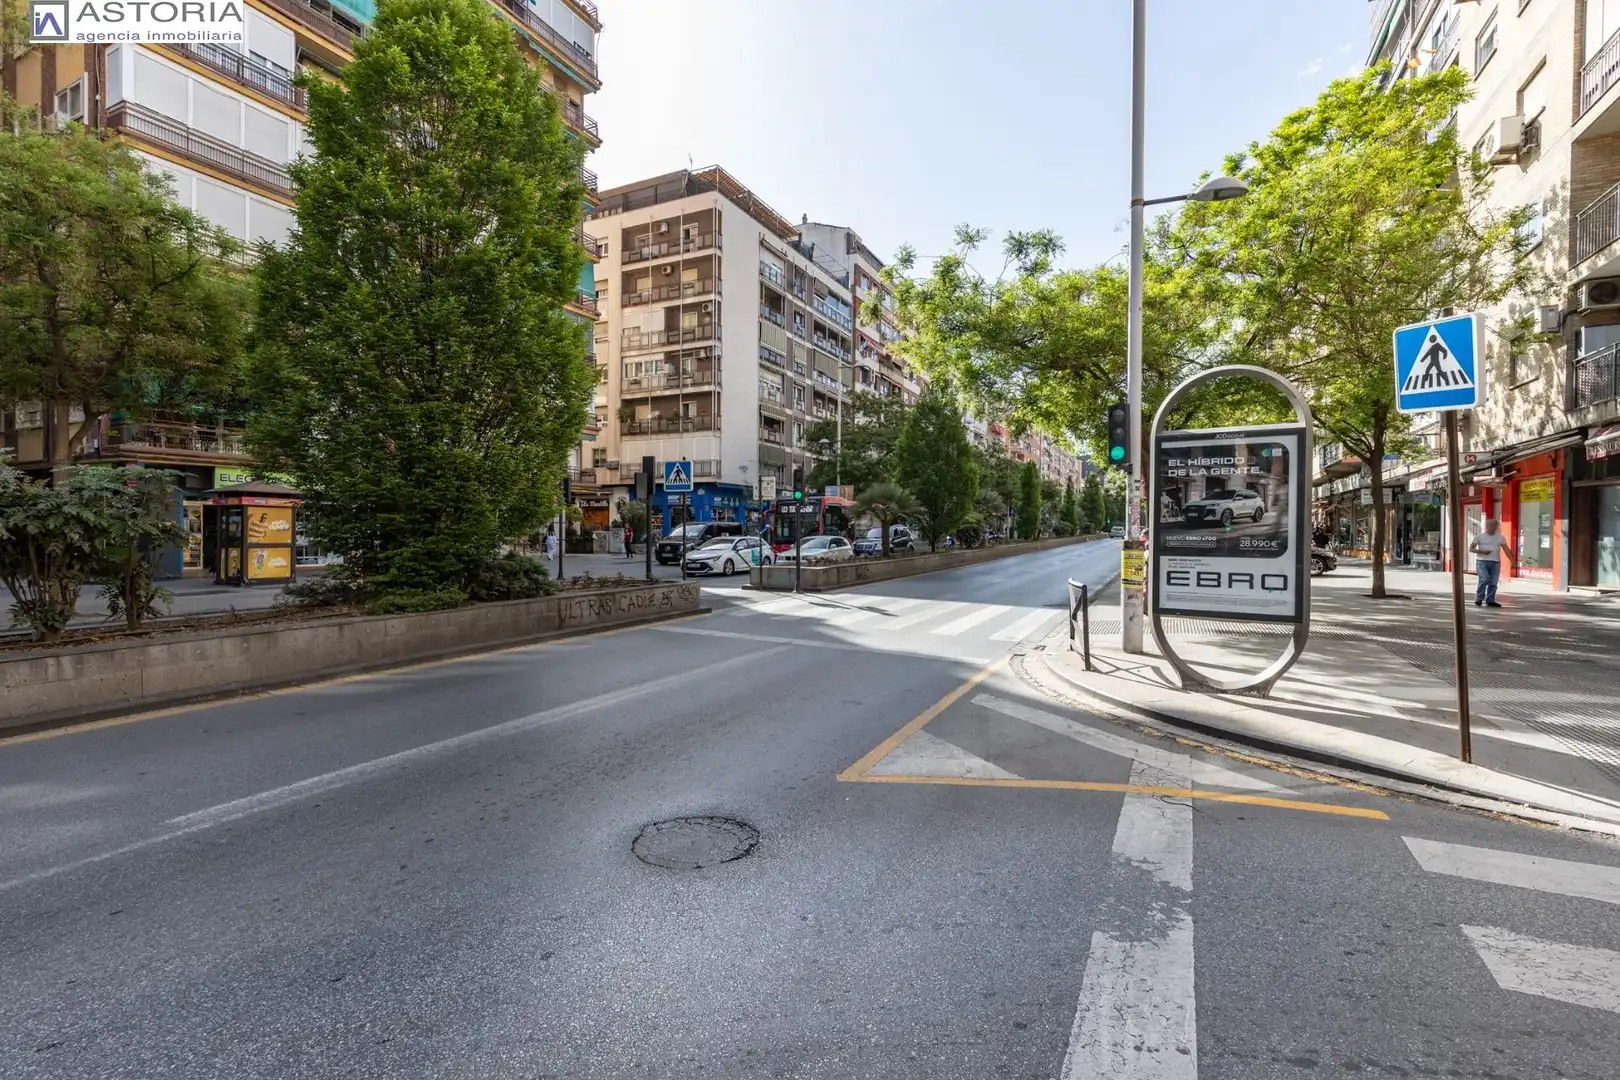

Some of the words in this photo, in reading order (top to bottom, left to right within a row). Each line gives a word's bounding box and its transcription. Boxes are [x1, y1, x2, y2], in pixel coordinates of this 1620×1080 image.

[1168, 459, 1185, 467] EL
[1187, 456, 1245, 466] HÍBRIDO
[1168, 469, 1187, 477] DE
[1189, 468, 1208, 476] LA
[1210, 466, 1264, 475] GENTE.
[1166, 570, 1288, 591] EBRO
[558, 598, 613, 623] ULTRAS
